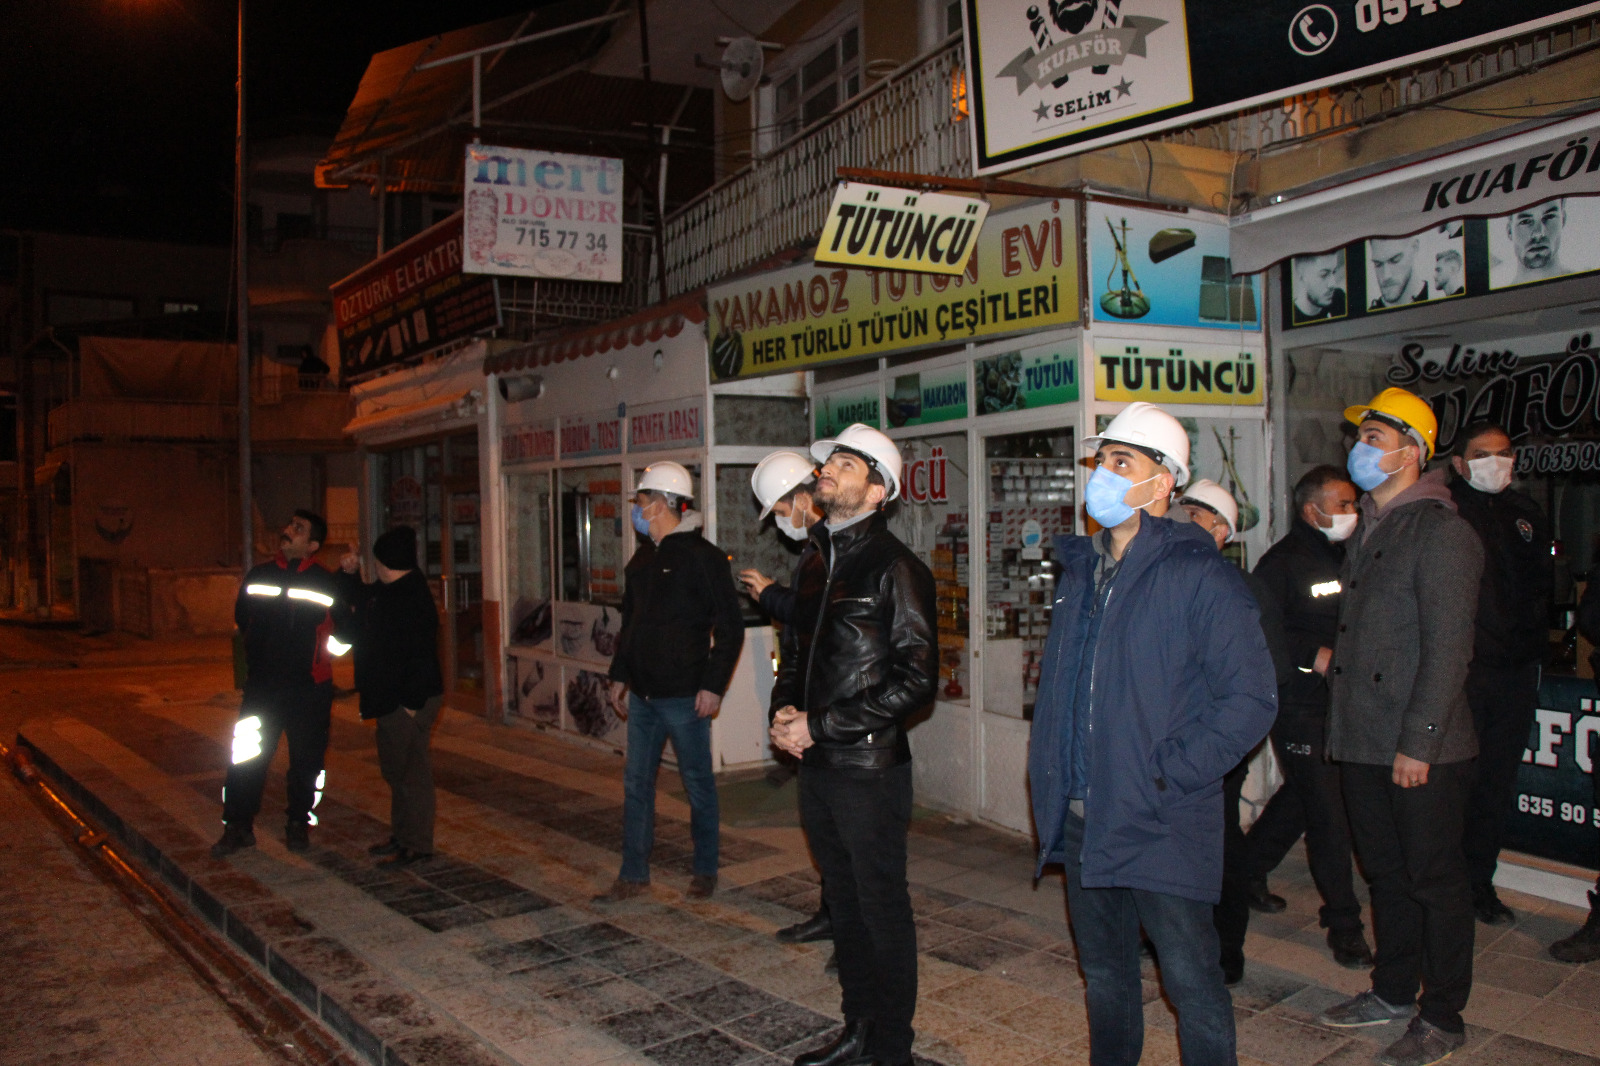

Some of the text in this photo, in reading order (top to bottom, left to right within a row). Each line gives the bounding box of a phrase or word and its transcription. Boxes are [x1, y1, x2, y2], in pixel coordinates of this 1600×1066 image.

[1354, 0, 1463, 33] 05
[1037, 34, 1122, 79] KUAFÖR
[1054, 90, 1112, 118] SELİM
[504, 187, 618, 225] DÖNER
[515, 227, 608, 252] 715 77 34
[829, 191, 979, 266] TÜTÜNCÜ
[713, 268, 849, 334] YAKAMOZ
[1001, 200, 1063, 278] EVİ
[752, 276, 1059, 366] HER TÜRLÜ TÜTÜN ÇEŞİTLERİ
[1025, 354, 1075, 391] TÜTÜN
[1100, 346, 1256, 395] TÜTÜNCÜ
[1386, 343, 1520, 384] Selim
[837, 397, 878, 424] NARGİLE
[923, 382, 967, 409] MAKARON
[1419, 331, 1600, 457] UAFÖ
[597, 420, 620, 449] TOST
[632, 407, 699, 446] EKMEK ARASI
[1521, 698, 1600, 774] FÖ
[1518, 794, 1553, 818] 635
[1560, 802, 1586, 825] 90
